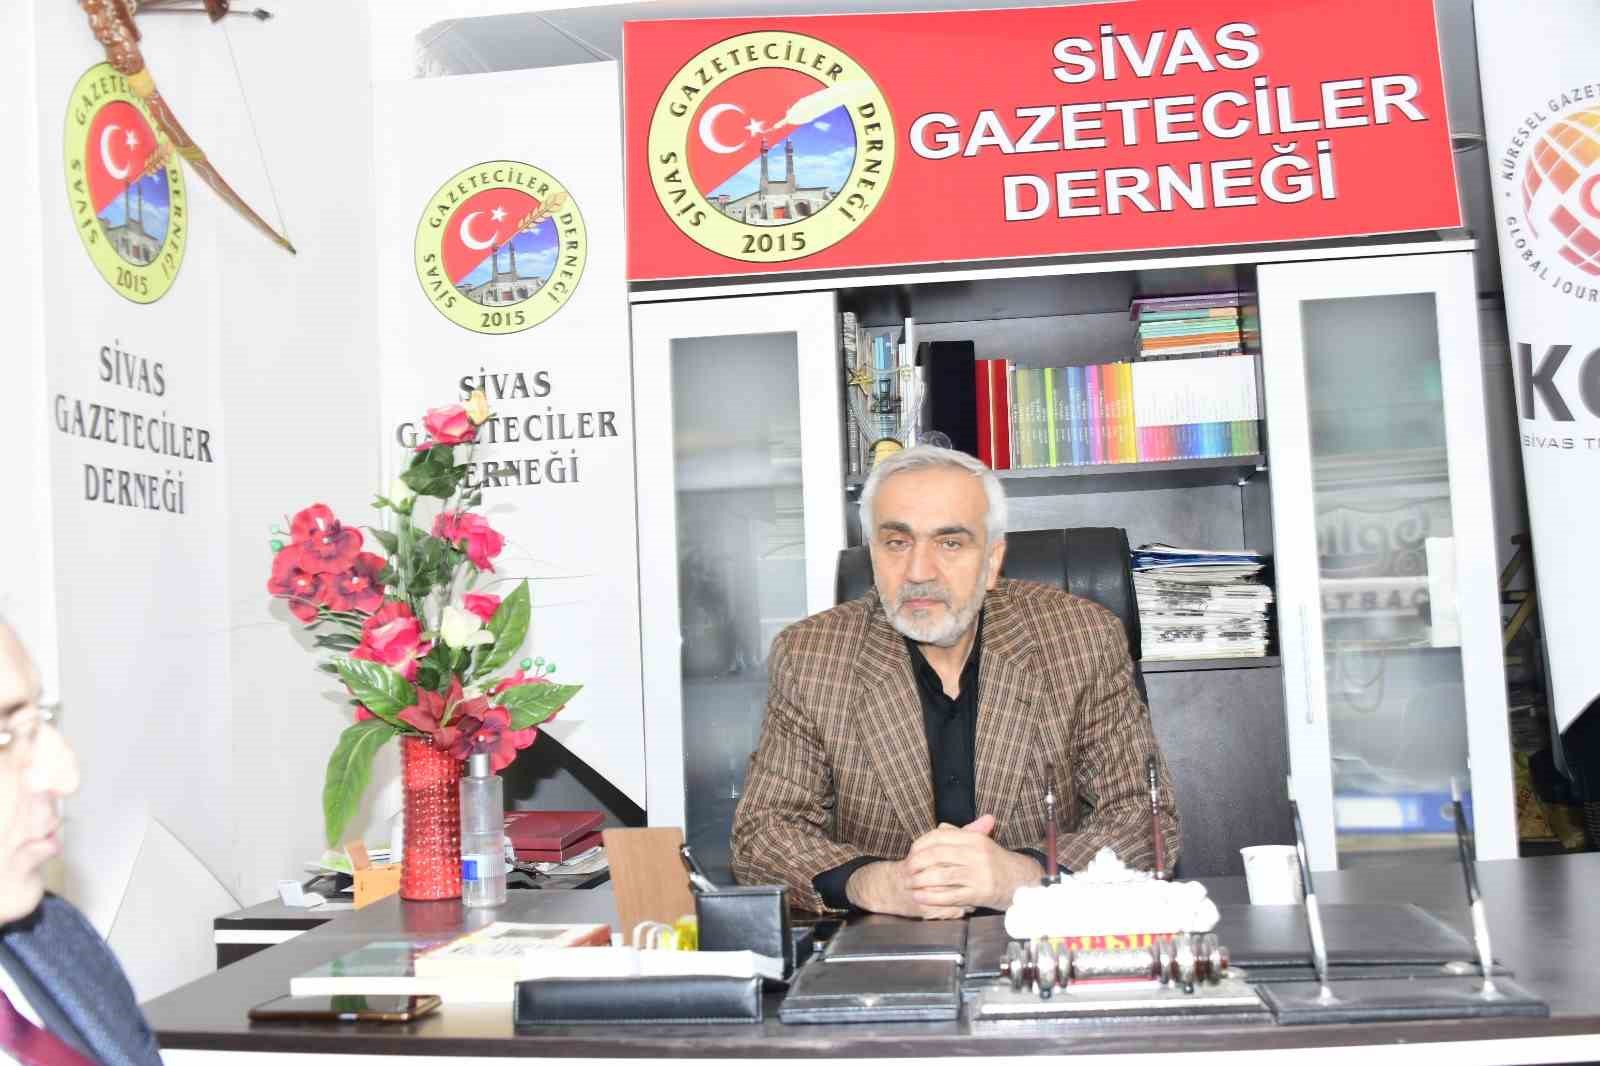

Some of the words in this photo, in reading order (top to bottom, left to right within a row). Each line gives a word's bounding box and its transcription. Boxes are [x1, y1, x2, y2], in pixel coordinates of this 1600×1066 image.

[670, 40, 844, 118] GAZETECİLER
[1052, 22, 1261, 84] SİVAS
[908, 74, 1429, 160] GAZETECİLER
[660, 151, 707, 226] SİVAS
[838, 101, 884, 222] DERNEĞİ
[1002, 139, 1337, 222] DERNEĞİ
[429, 167, 550, 229] GAZETECİLER
[741, 232, 806, 254] 2015
[1506, 215, 1549, 280] GLOBAL
[116, 266, 149, 295] 2015
[424, 252, 457, 309] SİVAS
[481, 310, 526, 328] 2015
[99, 338, 165, 397] SİVAS
[459, 367, 552, 401] SİVAS
[54, 393, 214, 463] GAZETECİLER
[396, 405, 618, 449] GTECİLER
[84, 463, 184, 514] DERNEĞİ
[462, 448, 580, 488] ERNEĞİ
